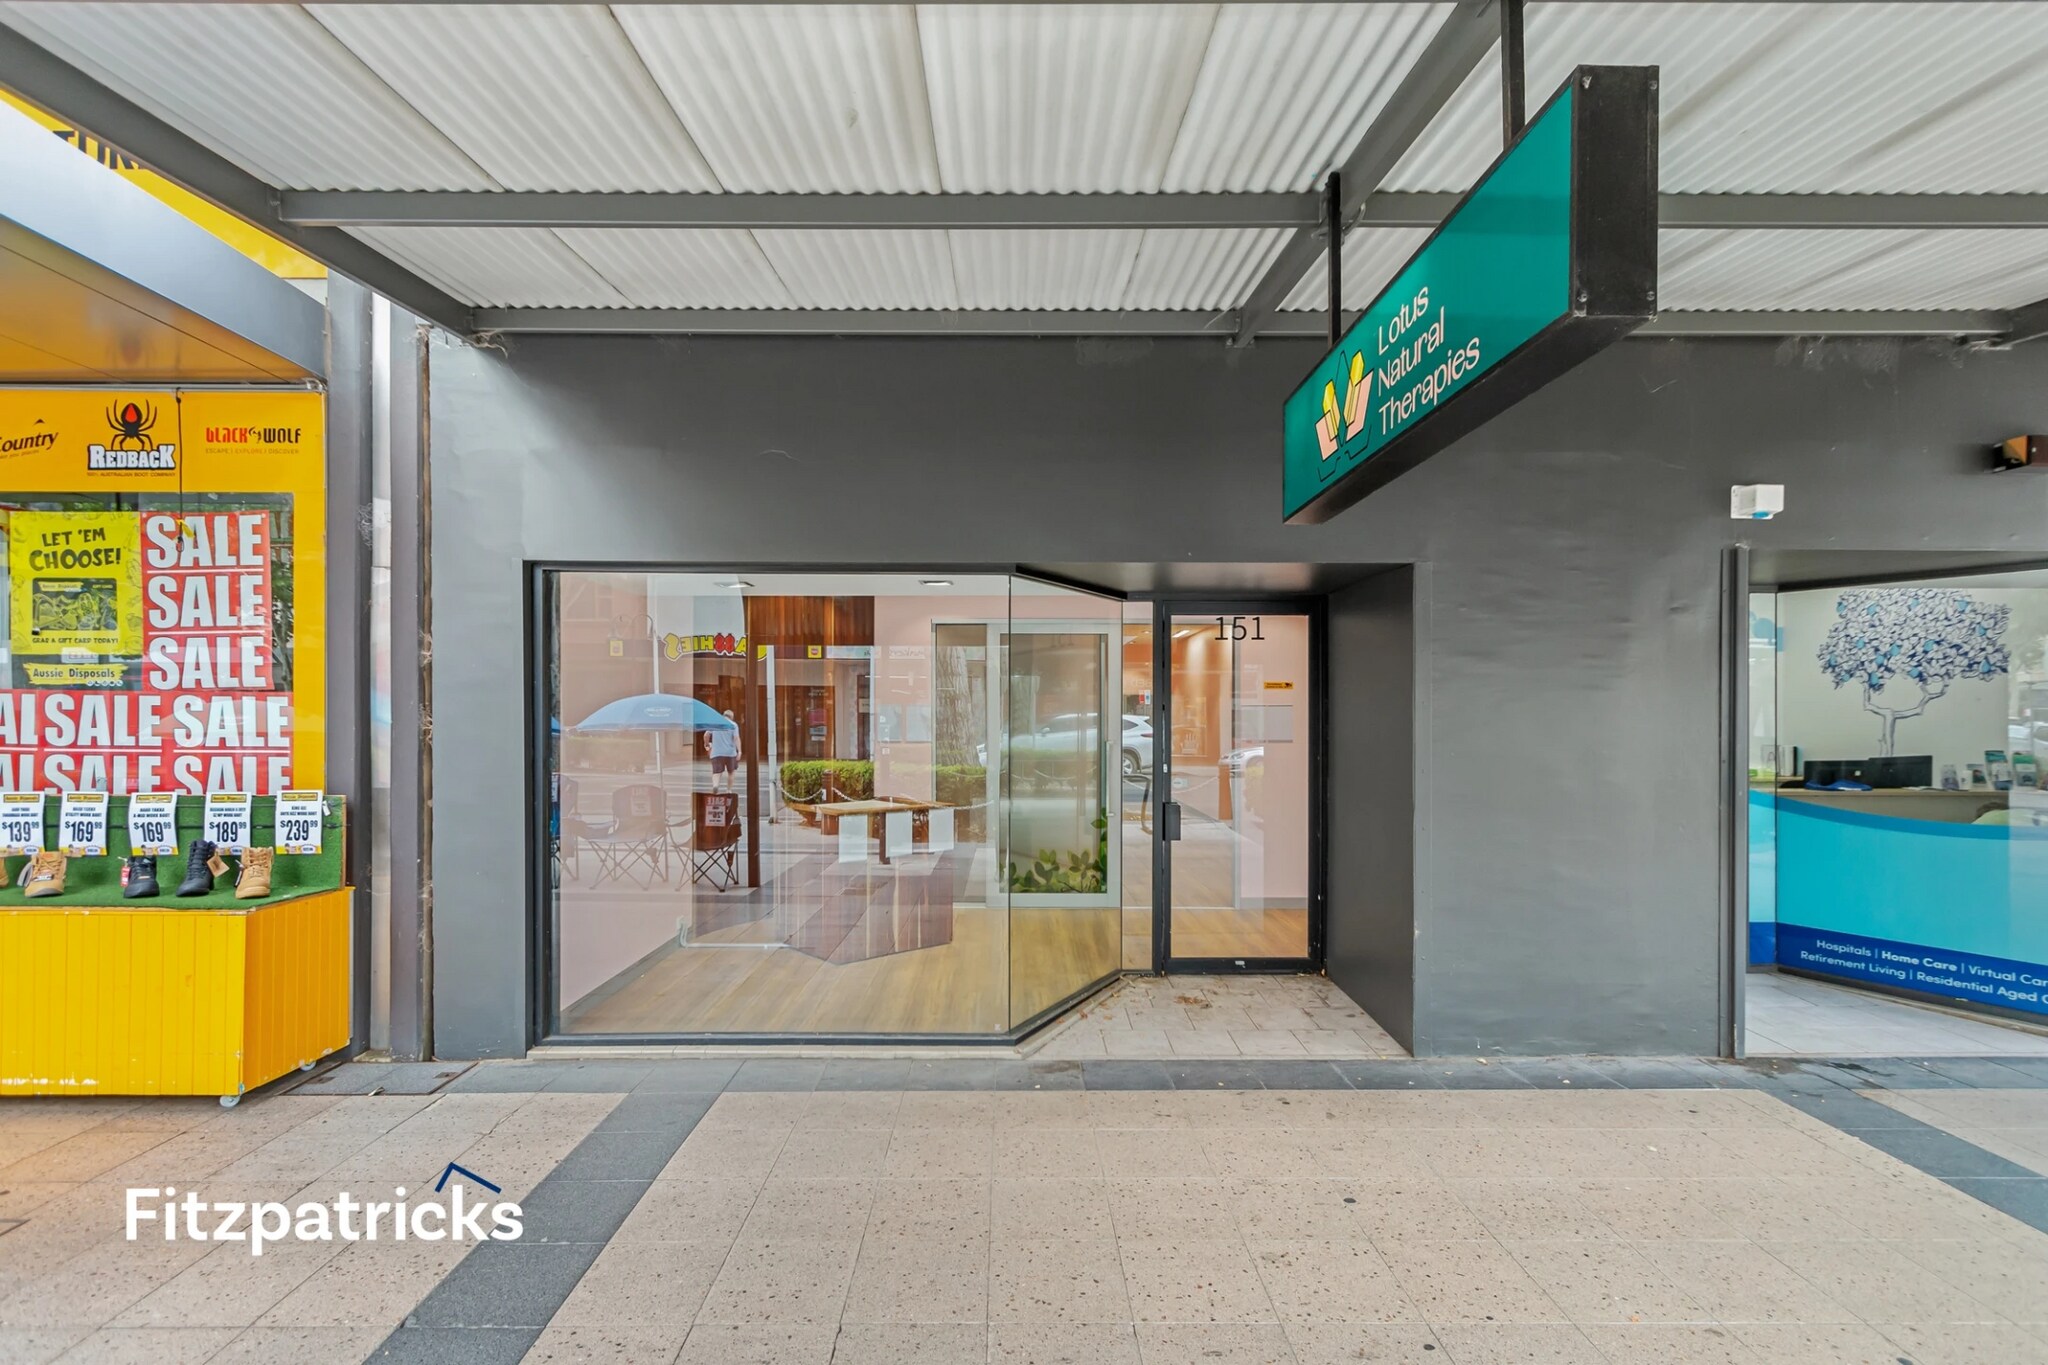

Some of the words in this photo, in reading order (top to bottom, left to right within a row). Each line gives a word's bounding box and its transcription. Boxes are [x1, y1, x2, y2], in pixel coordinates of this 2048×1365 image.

[1378, 286, 1429, 356] Lotus
[1378, 306, 1445, 397] Natural
[1378, 337, 1480, 435] Therapies
[0, 432, 59, 452] ountry
[263, 427, 301, 443] WOLF
[88, 444, 176, 470] REDBACK
[29, 547, 122, 572] CHOOSE!
[42, 529, 73, 547] LET
[146, 514, 264, 569] SALE
[148, 574, 265, 630] SALE
[1215, 616, 1265, 641] 151
[33, 668, 64, 678] Aussie
[69, 668, 115, 680] Disposals
[149, 635, 267, 692] SALE
[44, 693, 162, 747] SALE
[173, 694, 290, 748] SALE
[44, 754, 162, 795] SALE
[173, 755, 290, 796] SALE
[1800, 950, 1865, 970] Retirement
[1869, 963, 1906, 980] Living
[1917, 971, 1993, 994] Residential
[1997, 986, 2038, 1002] Aged
[1816, 939, 1872, 957] Hospitals
[1881, 950, 1919, 966] Home
[1923, 957, 1957, 972] Care
[1968, 965, 2016, 982] Virtual
